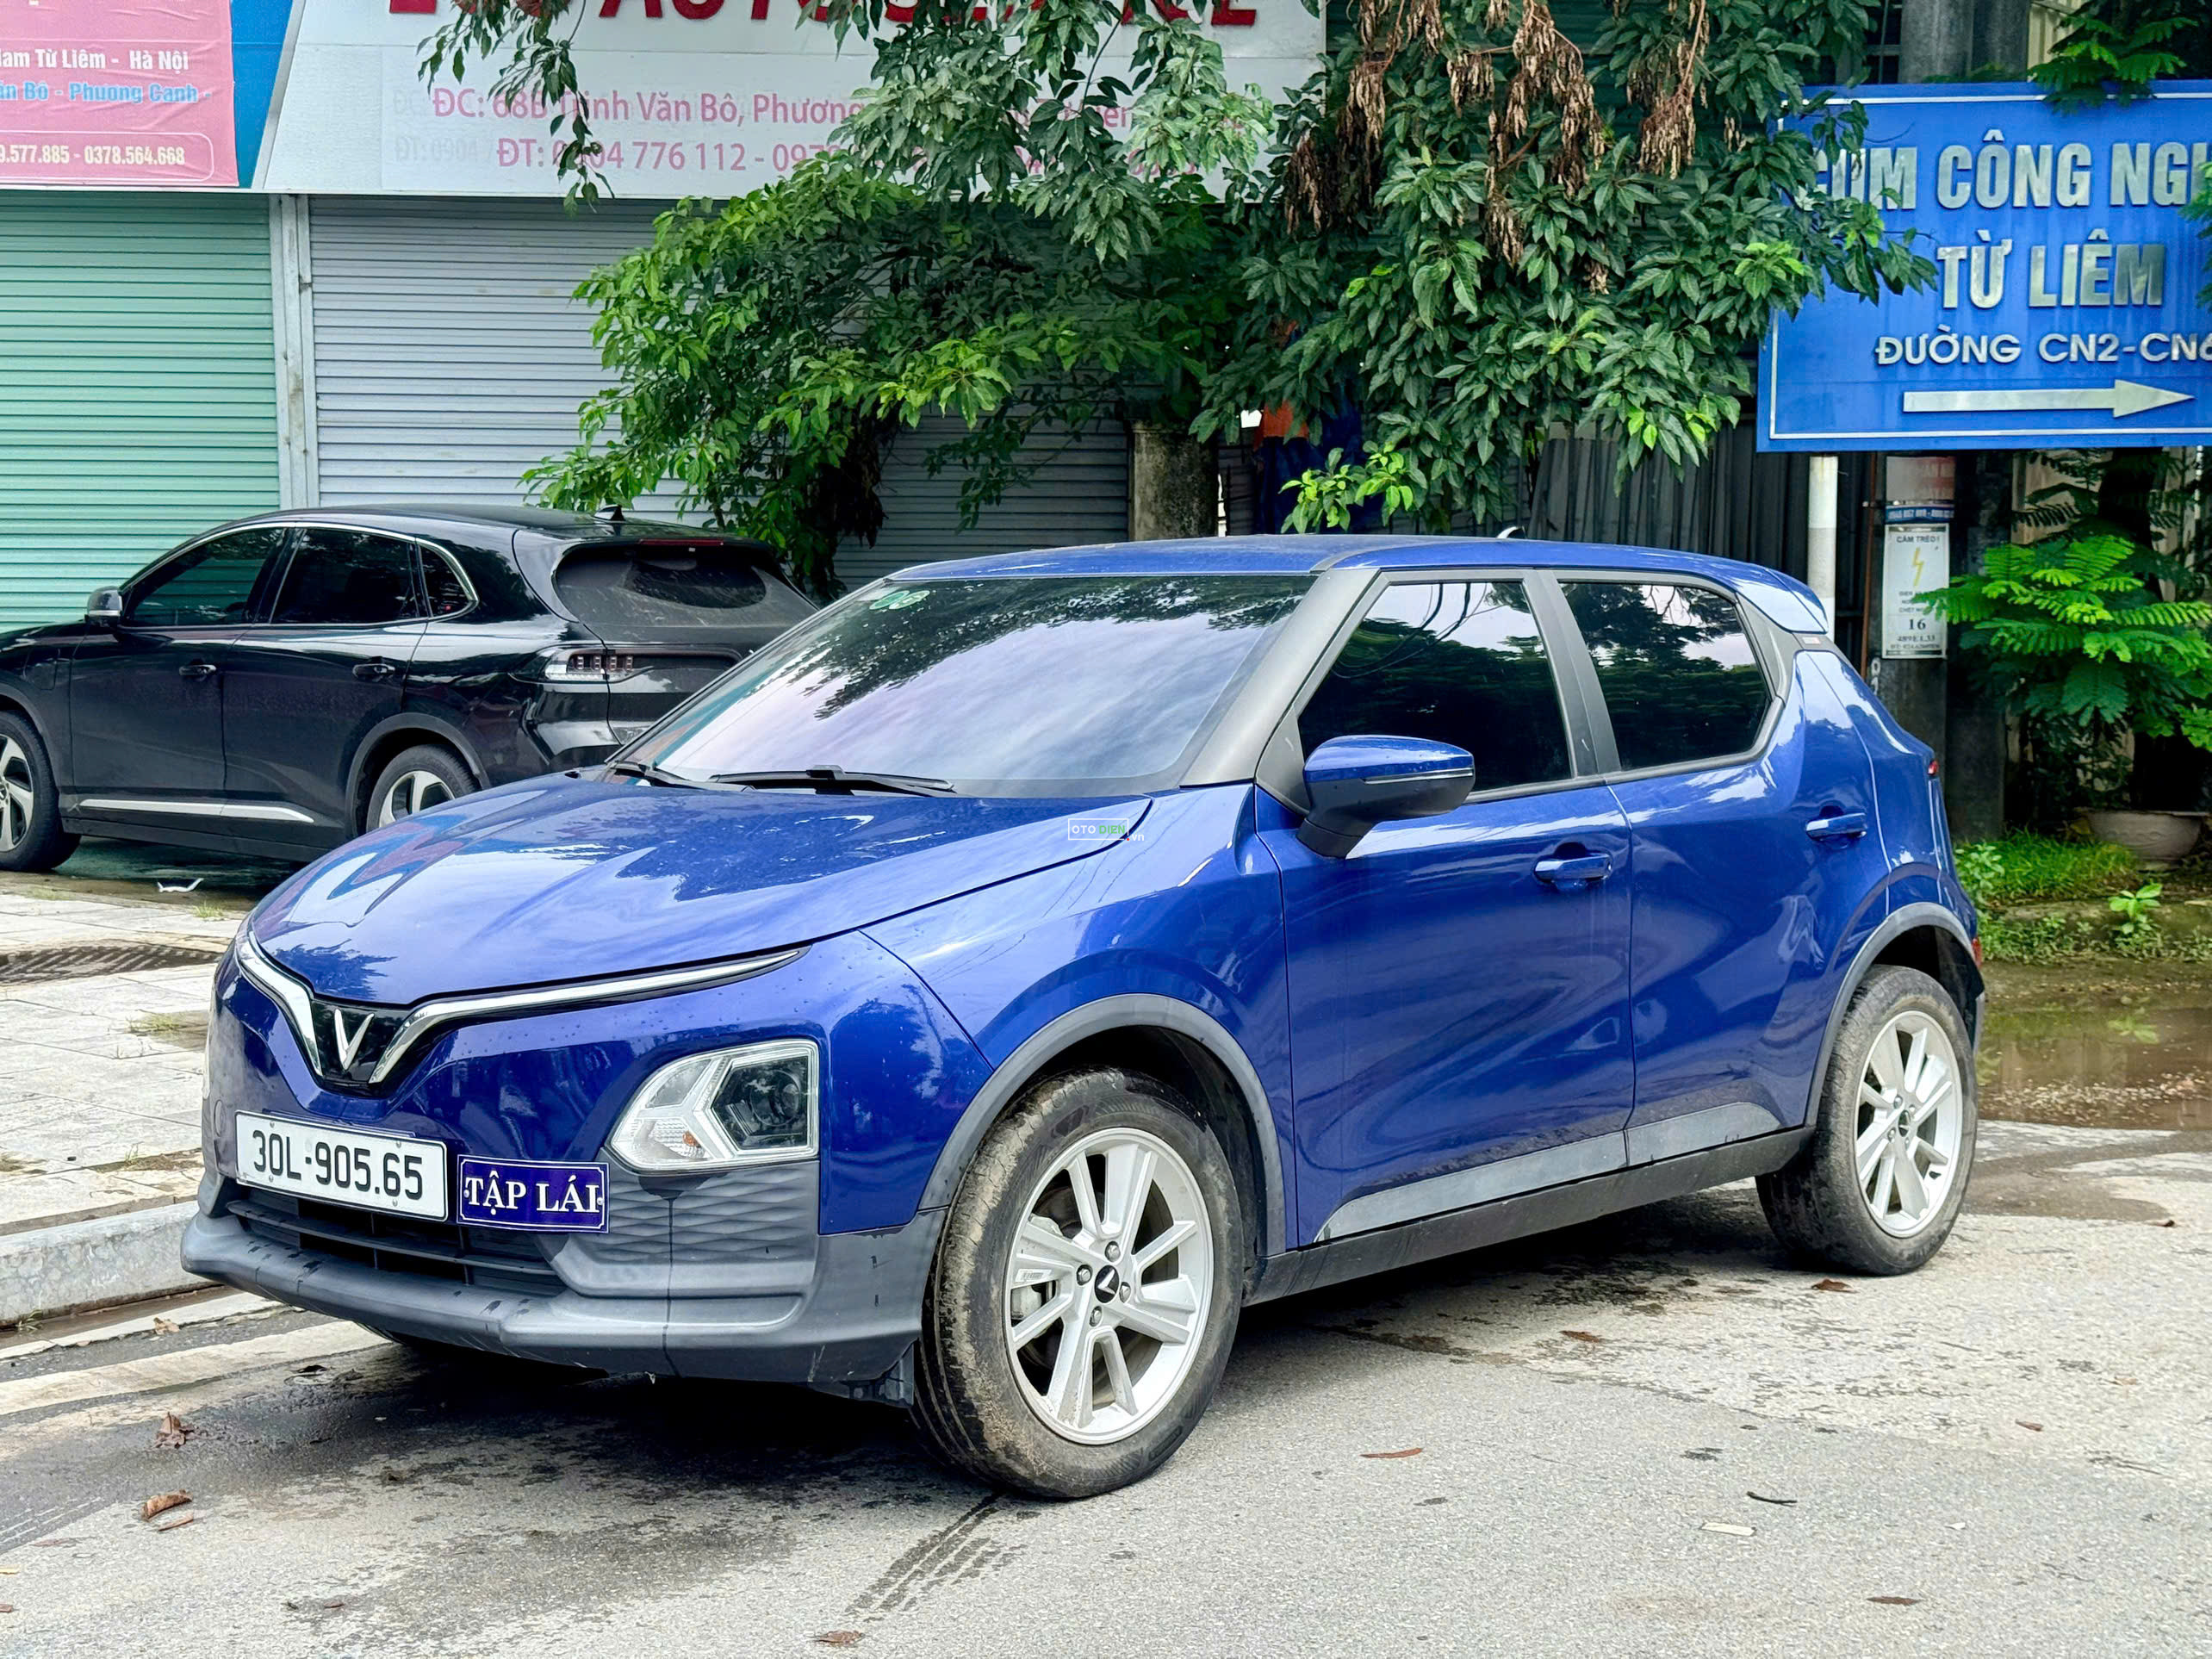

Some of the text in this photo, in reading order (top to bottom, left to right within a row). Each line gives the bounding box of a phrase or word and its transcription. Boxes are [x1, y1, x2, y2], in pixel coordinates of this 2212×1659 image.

[34, 48, 57, 68] Từ
[62, 49, 106, 69] Liêm
[129, 50, 153, 70] Hà
[158, 51, 189, 74] Nội
[432, 88, 484, 117] ĐC:
[636, 91, 691, 122] Văn
[84, 145, 185, 165] 0378.564.668
[497, 137, 544, 167] ĐT:
[632, 141, 686, 171] 776
[696, 142, 746, 171] 112
[1936, 129, 2091, 208] CÔNG
[1937, 228, 2166, 308] TỪ LIÊM
[1874, 324, 2022, 365] ĐƯỜNG
[1909, 618, 1926, 631] 16
[464, 1170, 601, 1215] TẬP LÁI
